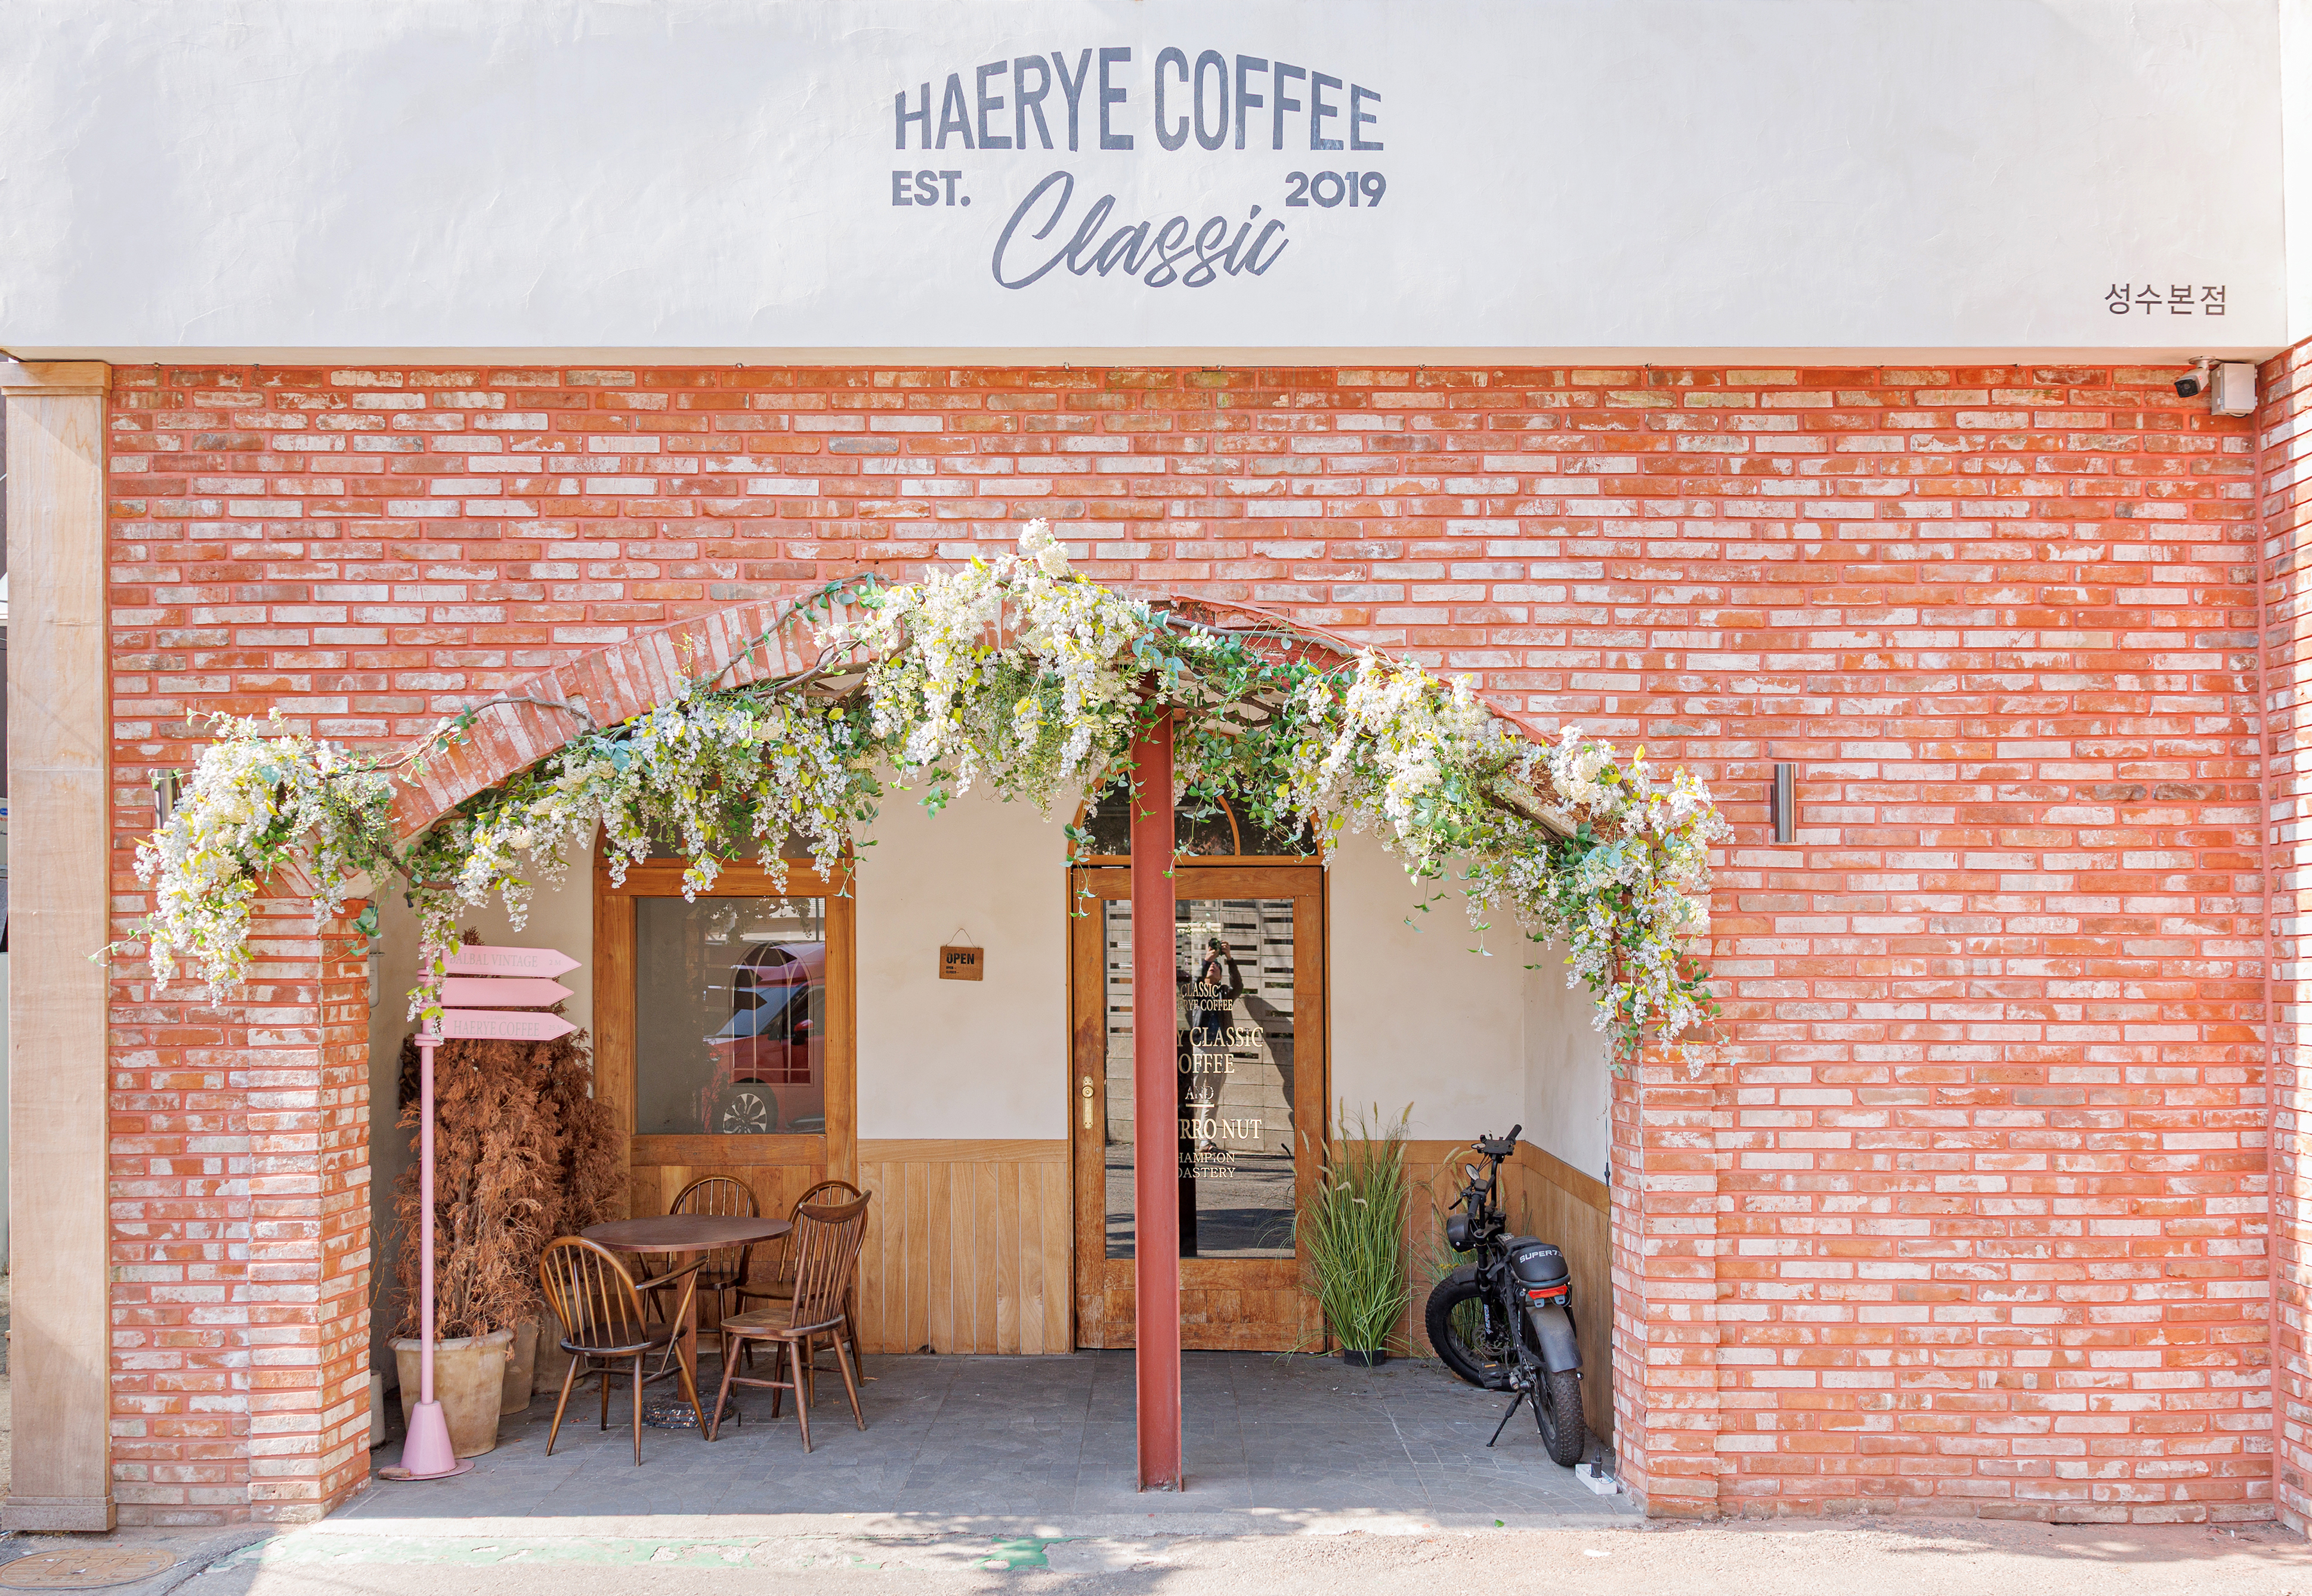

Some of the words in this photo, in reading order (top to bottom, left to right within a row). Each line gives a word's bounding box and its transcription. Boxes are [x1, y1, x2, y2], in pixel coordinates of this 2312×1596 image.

[896, 47, 1134, 151] HAERYE
[1155, 47, 1384, 151] COFFEE
[892, 171, 971, 207] EST.
[1285, 171, 1387, 208] 2019
[993, 171, 1289, 290] Classic
[2104, 283, 2226, 316] 성수본점
[449, 953, 489, 966] BALBAL
[492, 954, 538, 967] VINTAGE
[946, 952, 975, 964] OPEN
[1180, 982, 1219, 998] CLASSIC
[1200, 999, 1233, 1011] COFFEE
[453, 1020, 496, 1036] HAERYE
[499, 1022, 540, 1037] COFFEE
[1189, 1026, 1264, 1047] CLASSIC
[1177, 1053, 1235, 1074] OFFEE
[1185, 1085, 1214, 1100] AND
[1179, 1118, 1217, 1140] RRO
[1222, 1118, 1262, 1139] NUT
